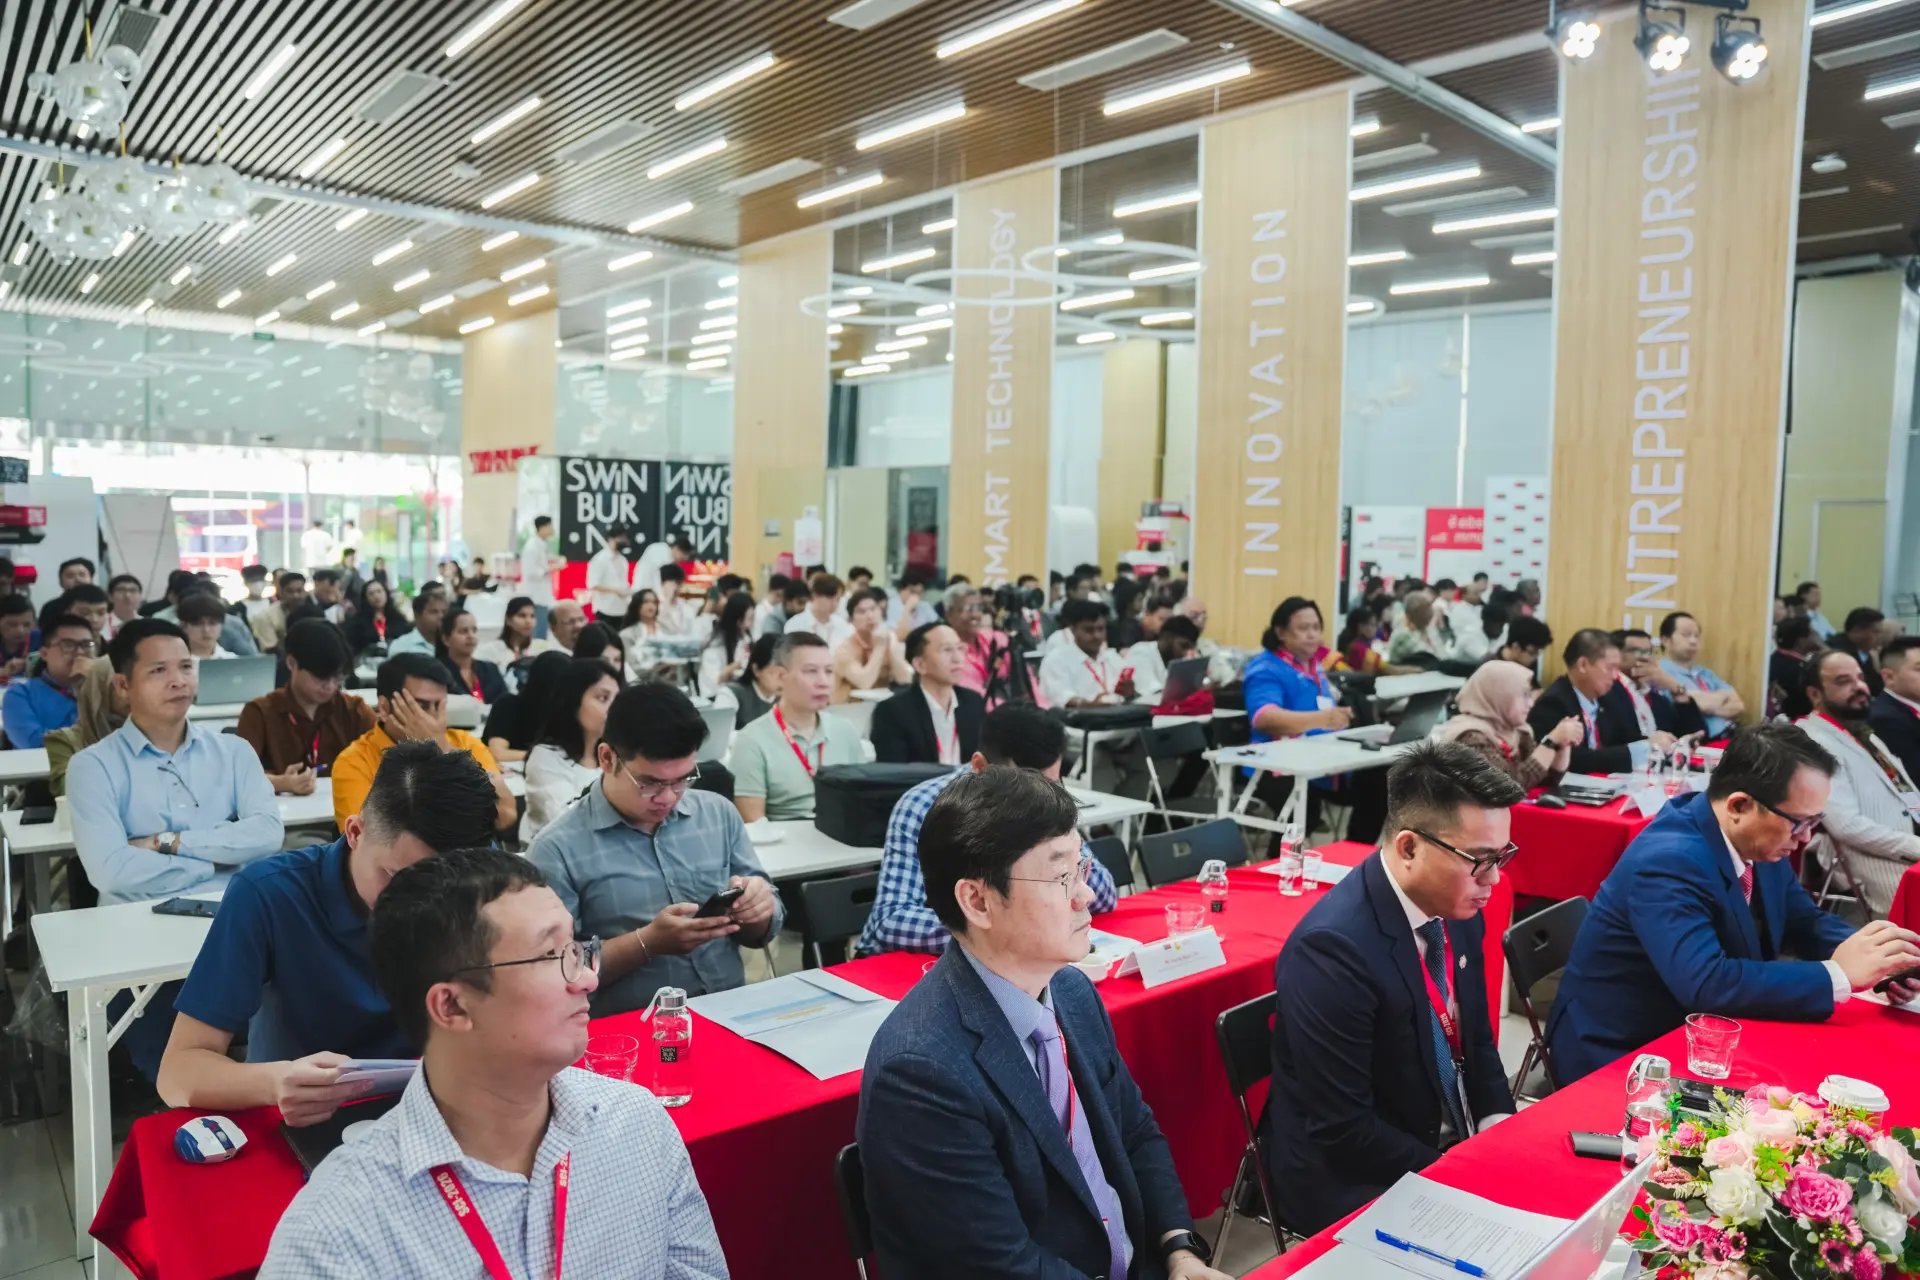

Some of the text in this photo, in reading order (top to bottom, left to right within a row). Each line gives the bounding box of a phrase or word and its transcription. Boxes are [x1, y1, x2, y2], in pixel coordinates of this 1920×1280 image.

[986, 209, 1016, 454] TECHNOLOGY
[1243, 209, 1288, 576] INNOVATION
[577, 491, 640, 524] BUR
[437, 1172, 470, 1217] SCI-2026
